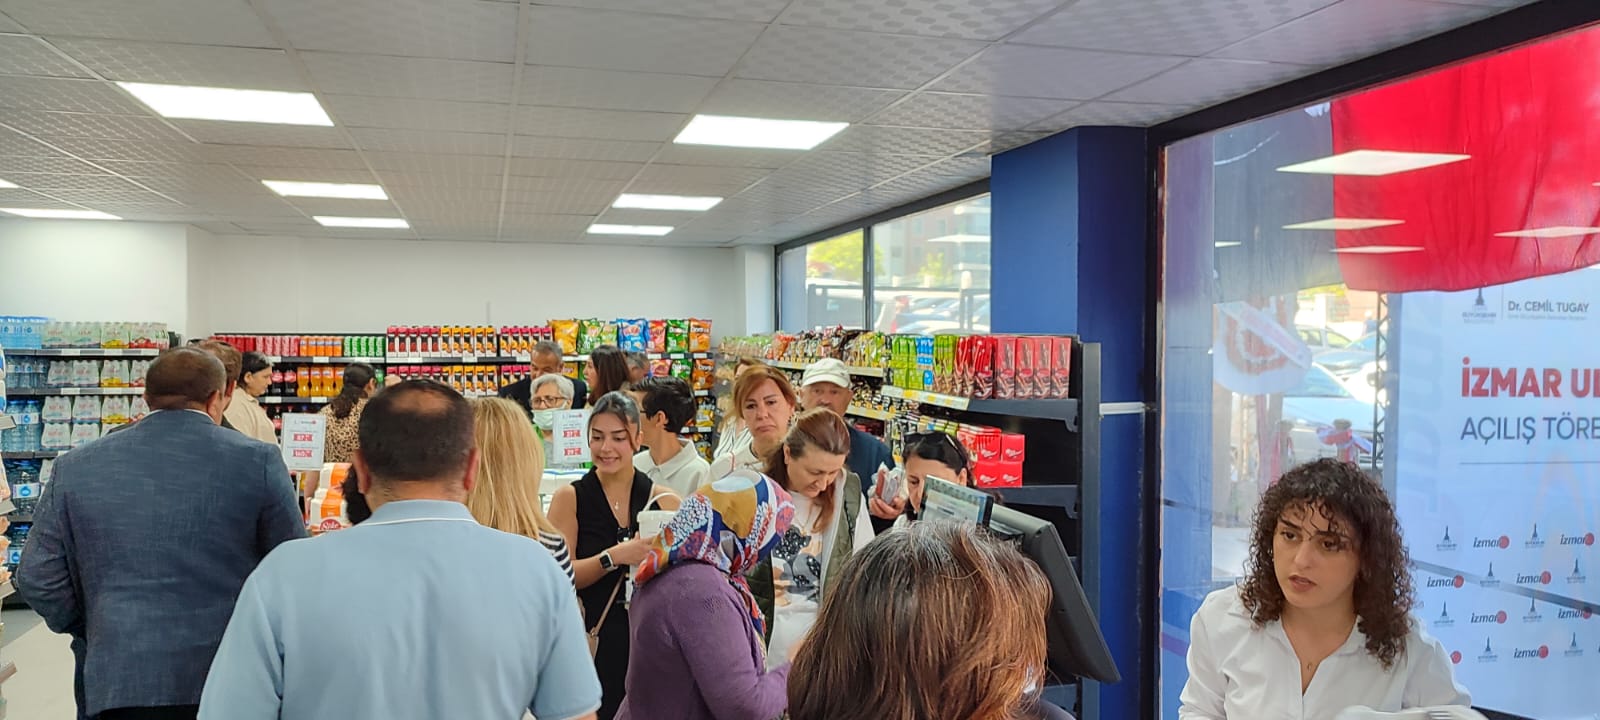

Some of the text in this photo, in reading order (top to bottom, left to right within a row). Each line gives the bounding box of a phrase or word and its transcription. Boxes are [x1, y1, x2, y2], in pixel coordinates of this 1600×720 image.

[1508, 299, 1590, 313] Dr. CEMİL TUGAY
[1461, 356, 1562, 398] İZMAR
[1460, 411, 1600, 445] AÇILIŞ TÖRE
